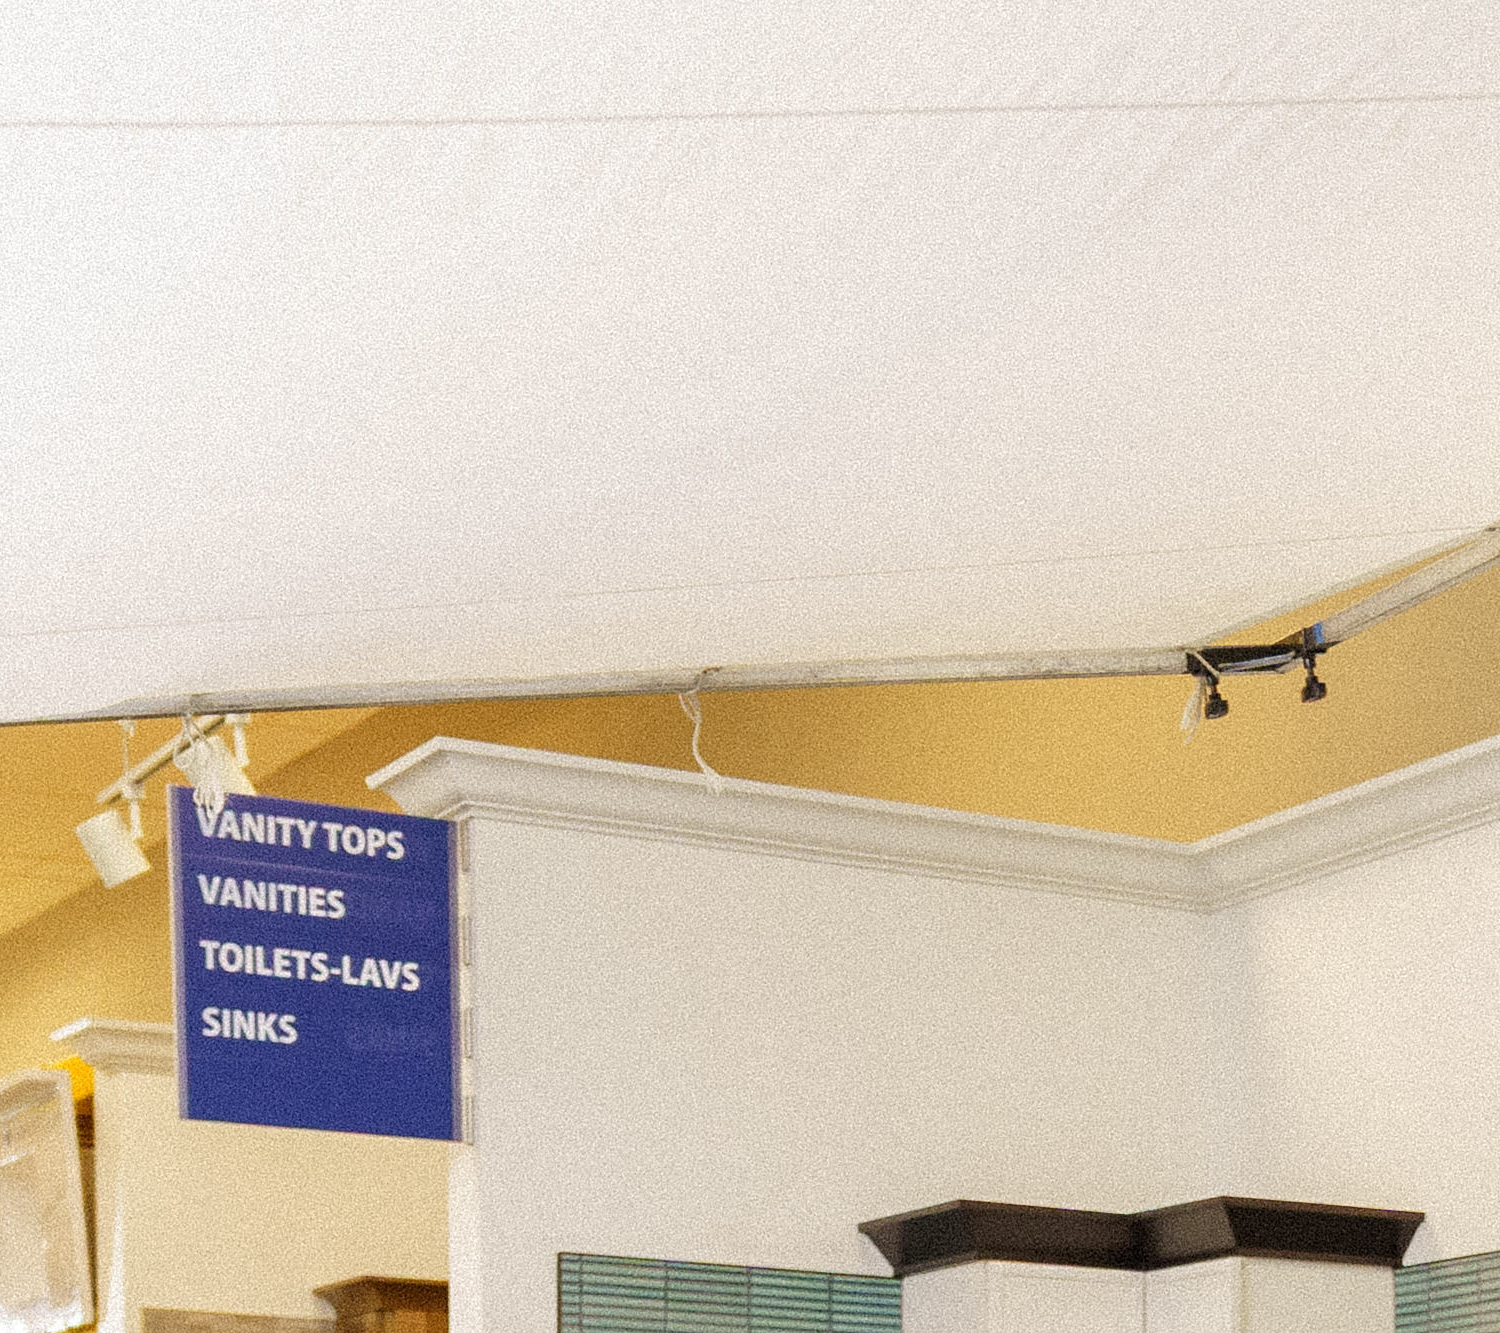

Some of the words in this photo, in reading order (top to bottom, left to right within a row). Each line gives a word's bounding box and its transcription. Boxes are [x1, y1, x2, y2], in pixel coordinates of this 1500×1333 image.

[196, 808, 318, 849] VANITY
[321, 821, 406, 860] TOPS
[197, 874, 347, 920] VANITIES
[198, 939, 421, 992] TOILETS-LAVS
[201, 1006, 299, 1045] SINKS
